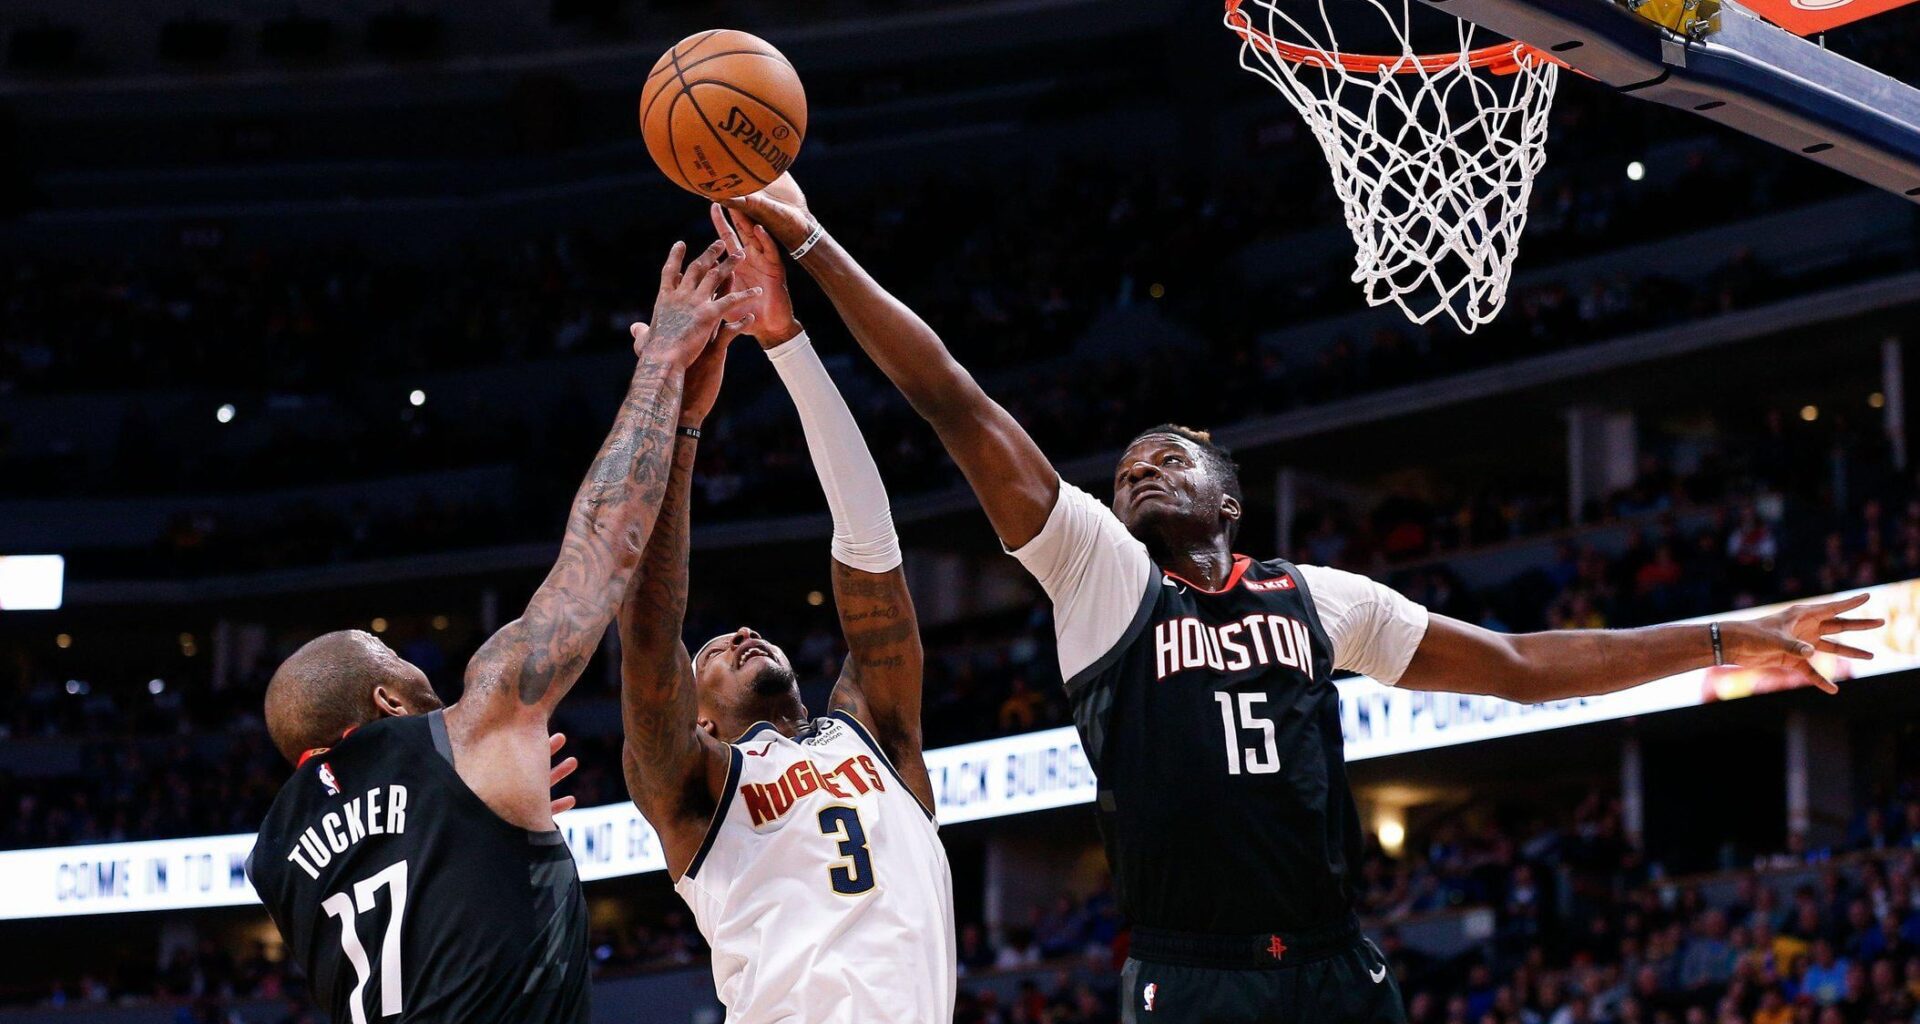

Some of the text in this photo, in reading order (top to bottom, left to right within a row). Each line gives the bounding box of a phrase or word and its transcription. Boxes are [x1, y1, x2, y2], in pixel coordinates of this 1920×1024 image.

[717, 105, 793, 175] SPALDIN
[1155, 613, 1315, 682] HOUSTON
[1214, 690, 1281, 775] 15
[927, 759, 990, 806] ACK
[287, 784, 408, 881] TUCKER
[817, 802, 878, 897] 3
[57, 859, 130, 900] COME
[321, 859, 409, 1024] 17
